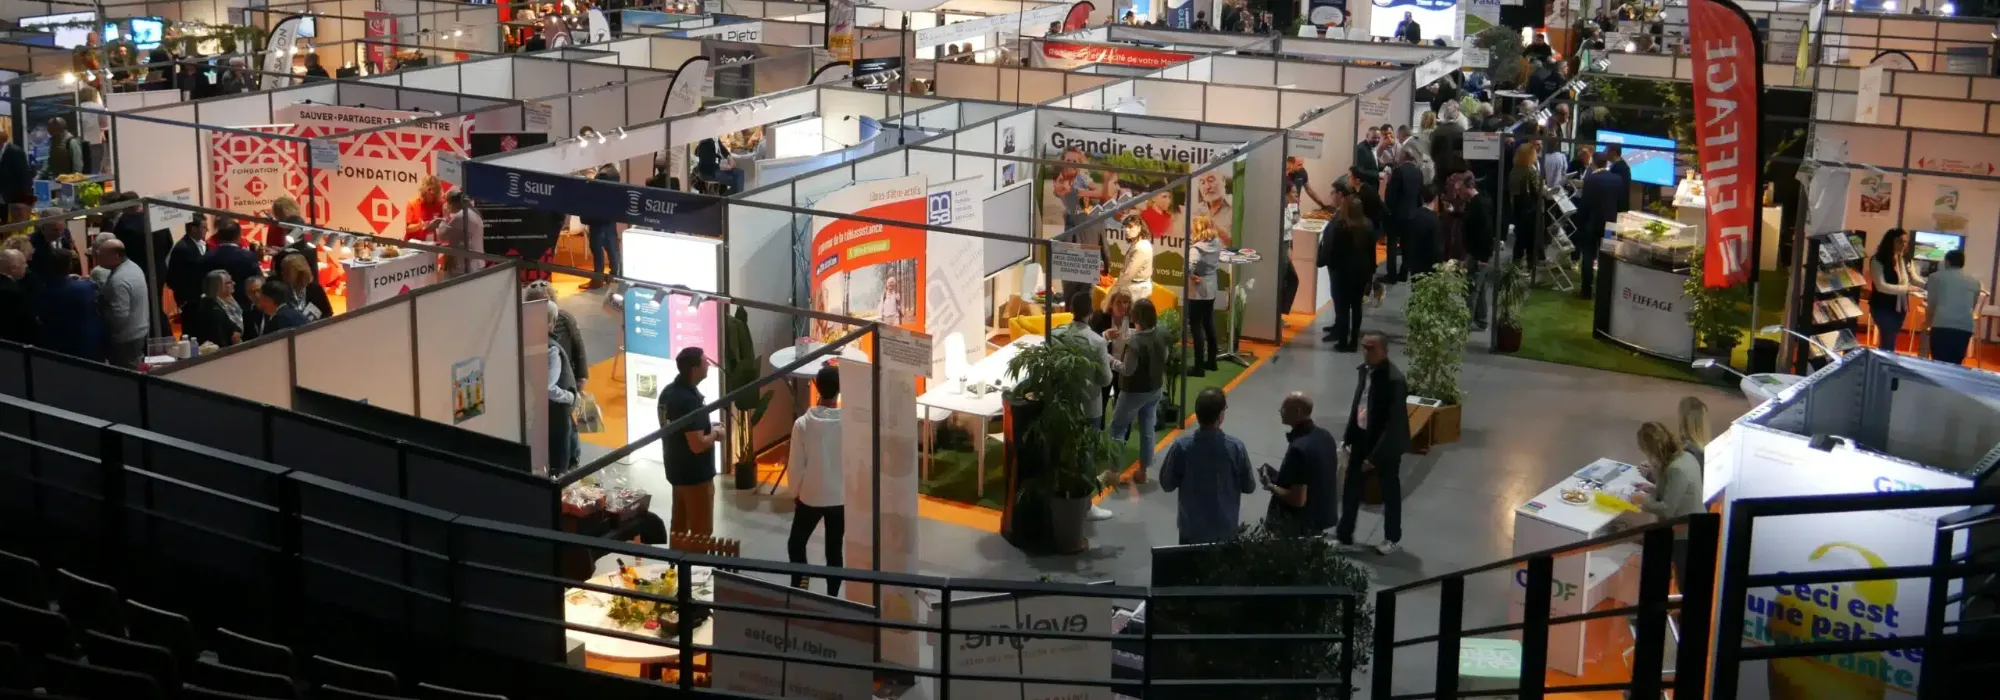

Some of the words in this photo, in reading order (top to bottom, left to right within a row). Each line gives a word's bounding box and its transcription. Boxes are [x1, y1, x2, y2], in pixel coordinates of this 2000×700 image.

[300, 110, 333, 121] SAUVER
[337, 115, 382, 125] PARTAGER
[1052, 132, 1126, 156] Grandir
[1133, 144, 1153, 159] et
[337, 166, 418, 184] FONDATION
[524, 181, 555, 196] saur
[645, 198, 677, 215] saur
[374, 264, 435, 288] FONDATION
[1632, 293, 1674, 312] EIFFAGE
[1747, 593, 1804, 626] une
[1848, 598, 1900, 628] est
